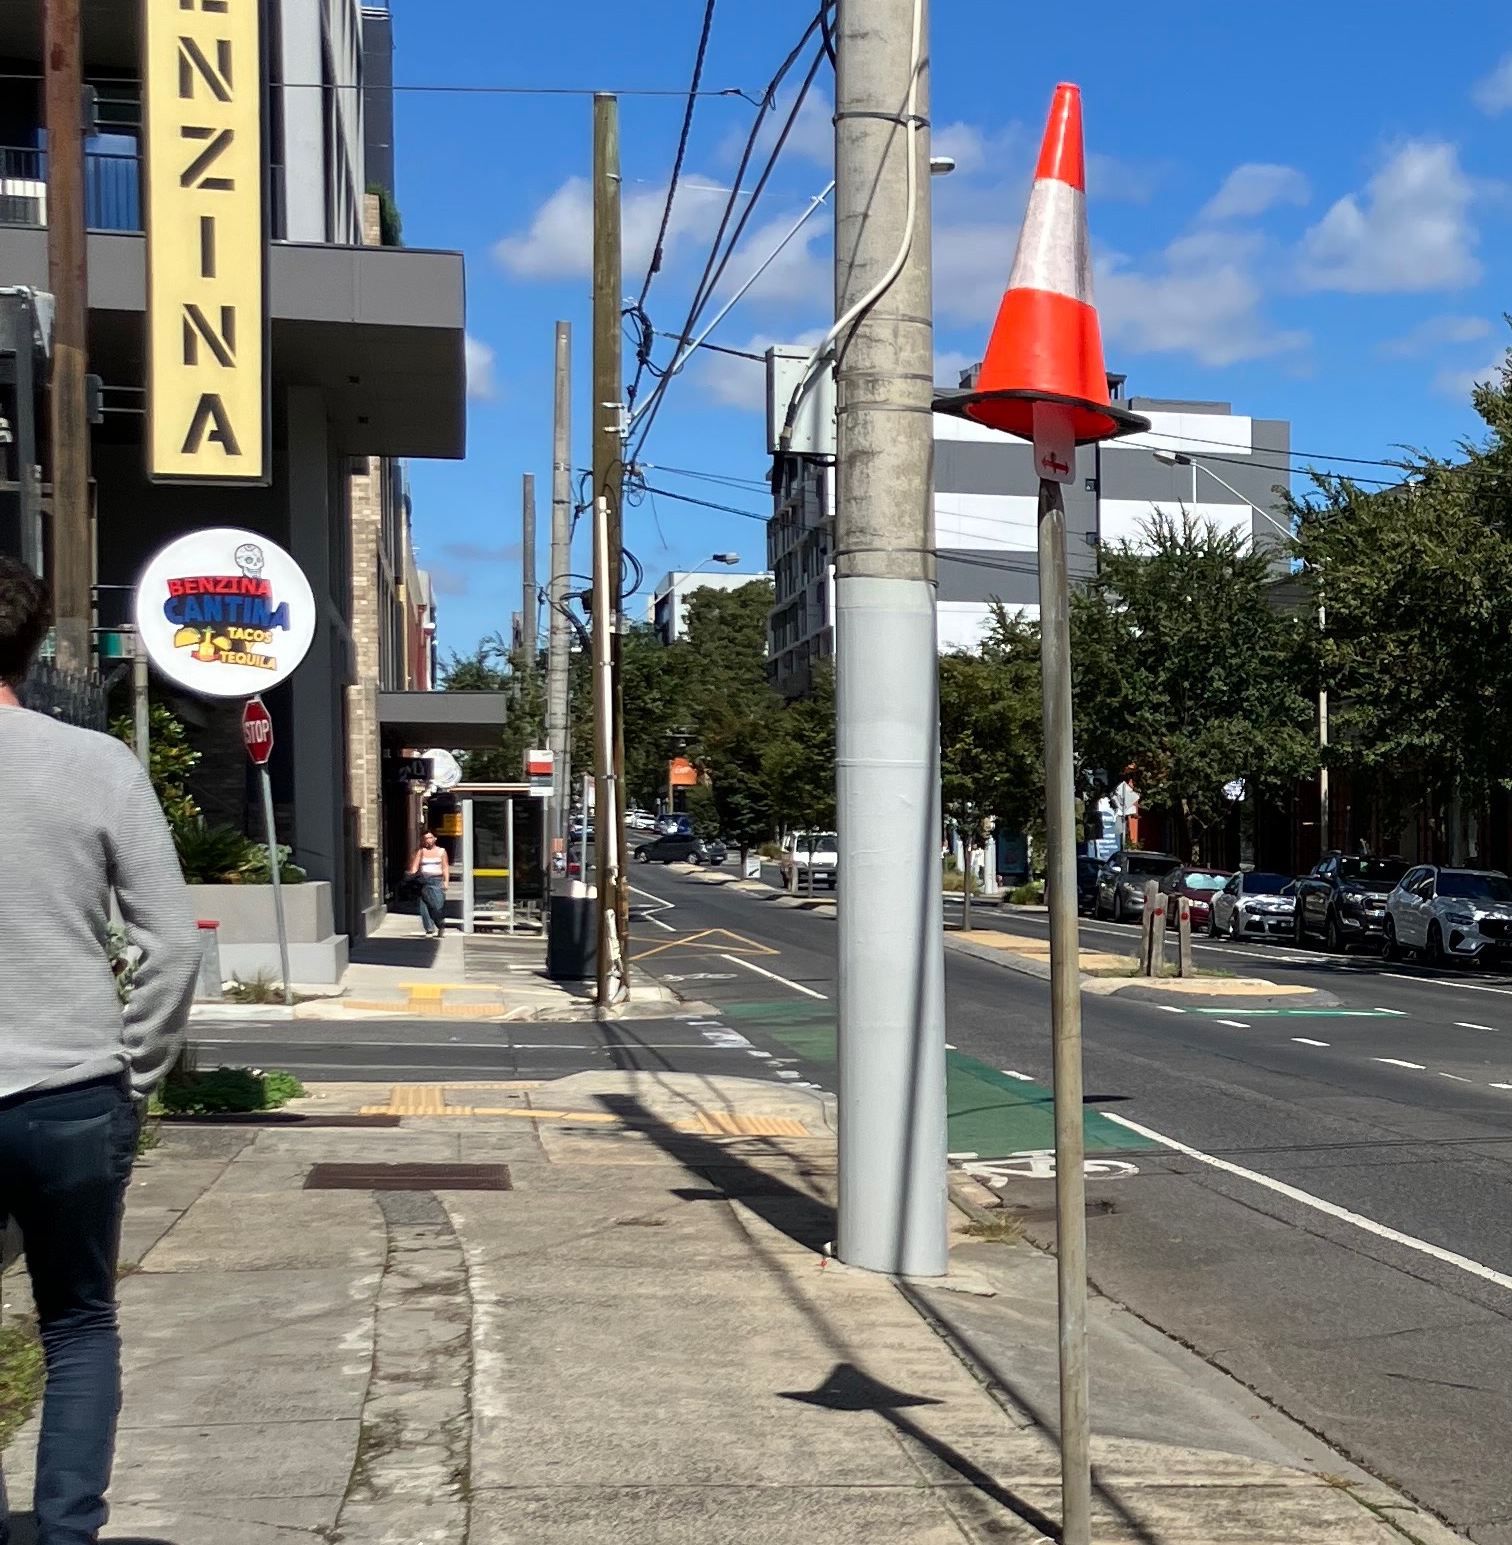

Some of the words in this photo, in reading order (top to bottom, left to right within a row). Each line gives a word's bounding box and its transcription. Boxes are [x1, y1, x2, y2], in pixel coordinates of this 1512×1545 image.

[167, 577, 272, 597] BENZINA
[163, 595, 291, 632] CANTINA
[220, 651, 277, 671] TEQUILA
[246, 719, 270, 744] STOP
